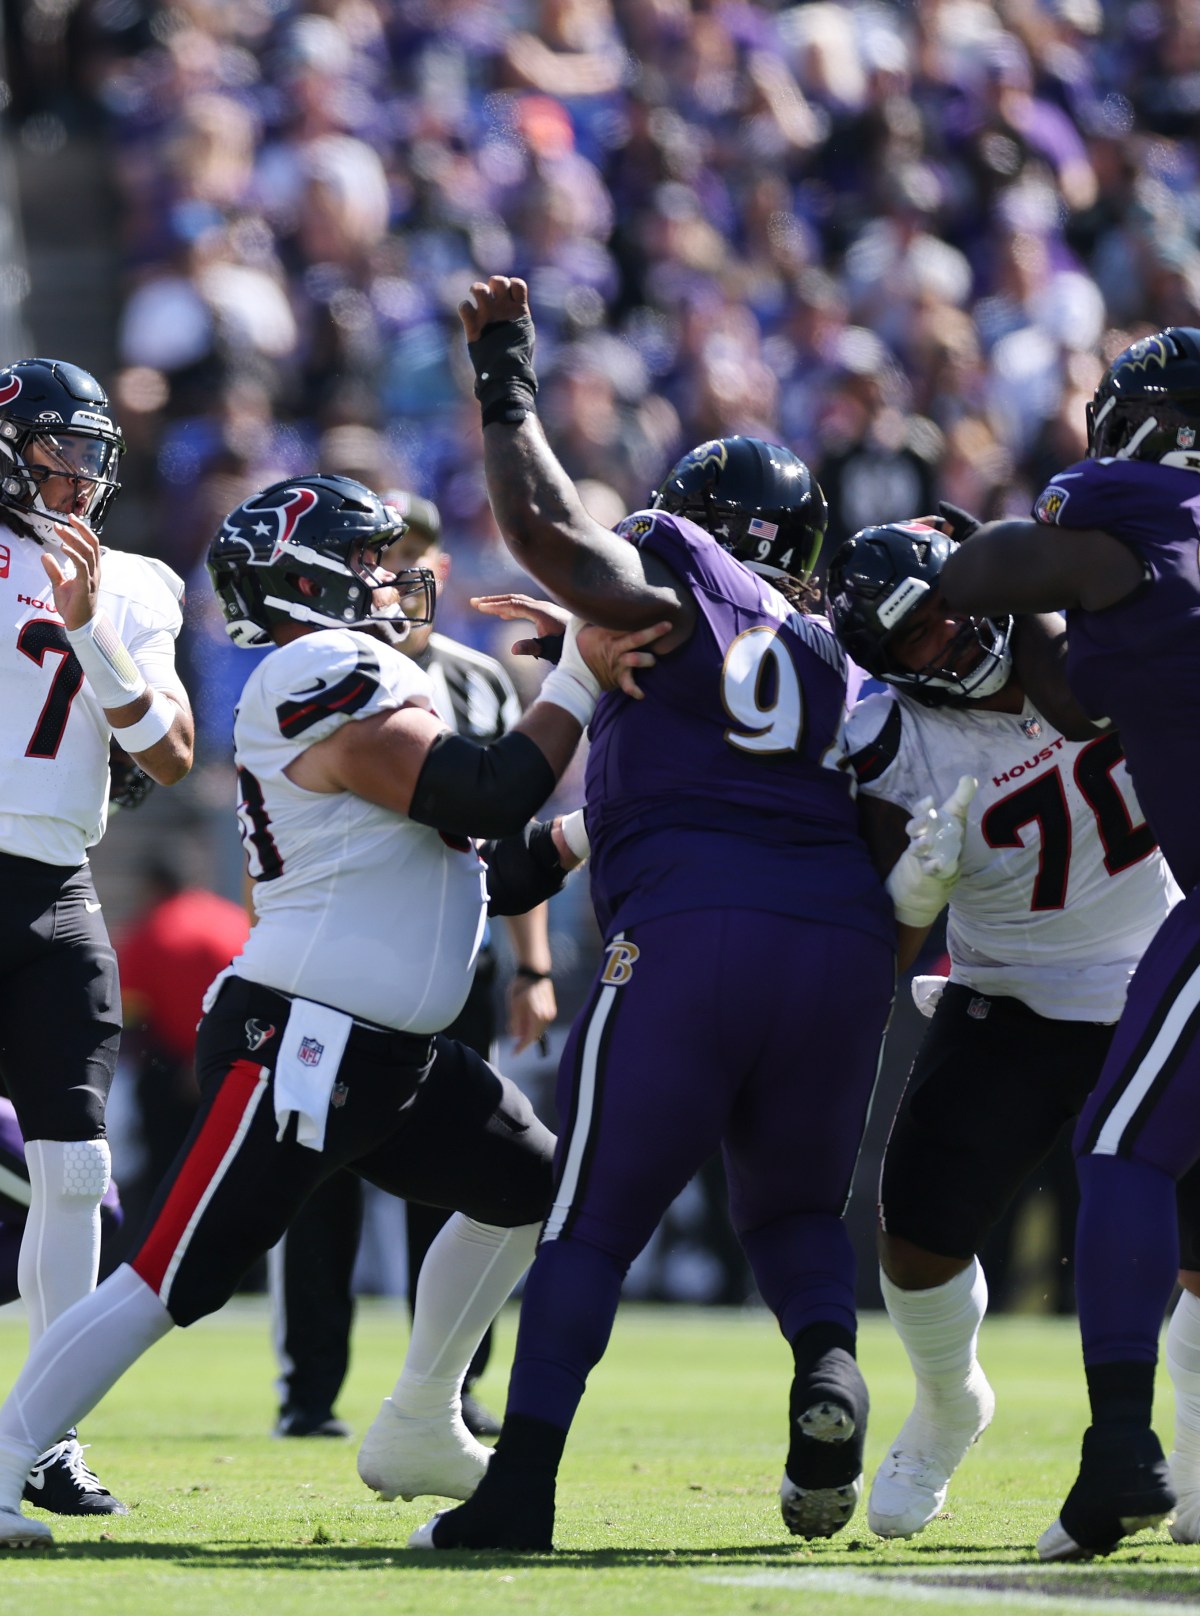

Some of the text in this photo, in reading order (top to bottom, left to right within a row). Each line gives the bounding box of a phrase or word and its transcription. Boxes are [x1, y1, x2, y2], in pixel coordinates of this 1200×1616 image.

[17, 593, 60, 613] HOU
[16, 617, 86, 759] 7
[991, 735, 1066, 788] HOUST
[600, 940, 641, 986] B
